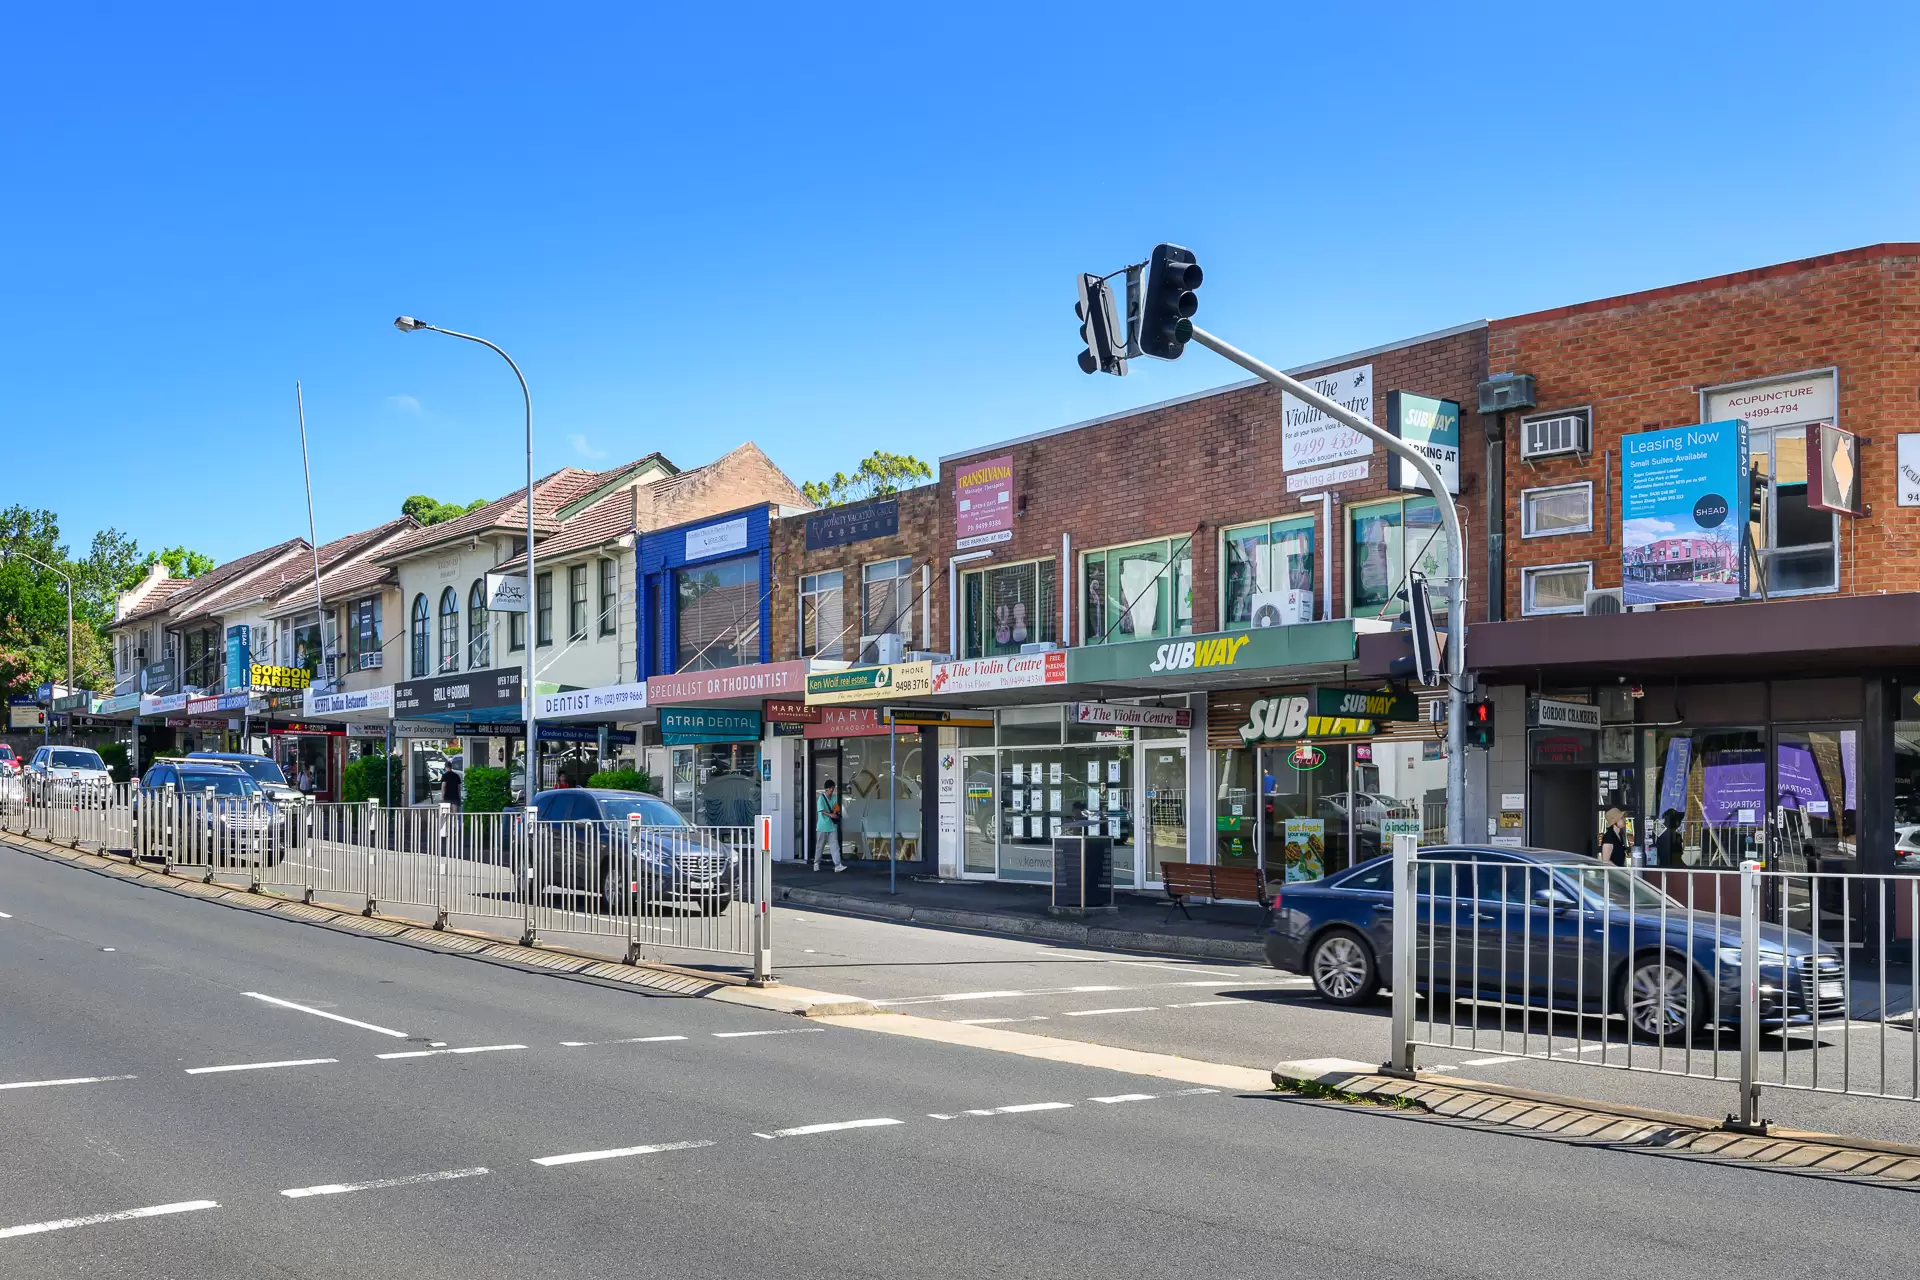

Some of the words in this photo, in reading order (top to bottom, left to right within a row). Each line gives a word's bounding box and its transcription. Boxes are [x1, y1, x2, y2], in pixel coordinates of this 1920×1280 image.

[1315, 380, 1338, 397] The
[1728, 386, 1813, 408] ACUPUNCTURE
[1286, 405, 1321, 428] Violin
[1744, 403, 1799, 420] 9499-4794
[1404, 408, 1456, 432] SUBWAY
[1300, 429, 1310, 437] your
[1325, 423, 1336, 431] Viola
[1288, 437, 1326, 459] 9499
[1330, 431, 1364, 450] 4330
[1630, 435, 1683, 454] Leasing
[1687, 431, 1720, 446] Now
[1740, 424, 1748, 477] SHEAD
[1297, 458, 1315, 466] VIOLINS
[1317, 453, 1337, 461] BOUGHT
[1445, 450, 1456, 463] AT
[1630, 459, 1650, 469] Small
[1651, 456, 1673, 466] Suites
[1675, 451, 1708, 462] Available
[959, 466, 1011, 488] TRANSILVANIA
[1288, 473, 1324, 489] Parking
[1326, 469, 1337, 480] at
[1338, 468, 1359, 479] rear
[964, 486, 983, 496] Massage
[983, 481, 1005, 491] Therapies
[823, 512, 846, 529] ROYALTY
[847, 507, 875, 523] VACATION
[1696, 506, 1726, 517] SHEAD
[959, 539, 970, 548] FREE
[970, 535, 989, 546] PARKING
[997, 532, 1010, 540] REAR
[498, 582, 521, 594] über
[1049, 654, 1061, 662] FREE
[1149, 634, 1250, 673] SUBWAY
[251, 664, 311, 679] GORDON
[901, 666, 924, 675] PHONE
[952, 663, 970, 677] The
[973, 660, 1002, 675] Violin
[1006, 657, 1043, 673] Centre
[251, 675, 310, 689] BARBER
[497, 676, 506, 686] OPEN
[650, 681, 703, 699] SPECIALIST
[707, 671, 788, 694] ORTHODONTIST
[809, 679, 822, 690] Ken
[823, 678, 838, 689] Wolf
[839, 677, 851, 686] real
[851, 676, 868, 685] estate
[895, 680, 912, 692] 9498
[912, 678, 929, 690] 3716
[1026, 674, 1043, 684] 4330
[251, 684, 265, 692] 764
[433, 687, 446, 701] GRILL
[451, 684, 470, 700] GORDON
[187, 700, 203, 716] GORDON
[202, 698, 218, 713] BARBER
[331, 696, 344, 712] Indian
[345, 694, 368, 710] Restaurant
[546, 695, 590, 712] DENTIST
[594, 696, 603, 705] Ph:
[603, 694, 615, 706] (02)
[615, 693, 628, 703] 9739
[629, 691, 643, 701] 9666
[771, 705, 817, 714] MARVEL
[1339, 693, 1397, 715] SUBWAY
[666, 715, 704, 727] ATRIA
[708, 717, 756, 728] DENTAL
[825, 708, 878, 724] MARVE
[1092, 707, 1111, 721] The
[1114, 708, 1141, 723] Violin
[1143, 709, 1173, 724] Centre
[1542, 705, 1567, 721] GORDON
[1567, 708, 1598, 725] CHAMBERS
[398, 724, 413, 733] über
[413, 725, 453, 735] photography
[478, 725, 494, 733] GRILL
[499, 725, 521, 734] GORDON
[562, 730, 577, 738] Child
[1287, 824, 1300, 832] eat
[1301, 823, 1322, 832] fresh
[1384, 822, 1391, 832] 6
[1391, 821, 1420, 832] inches
